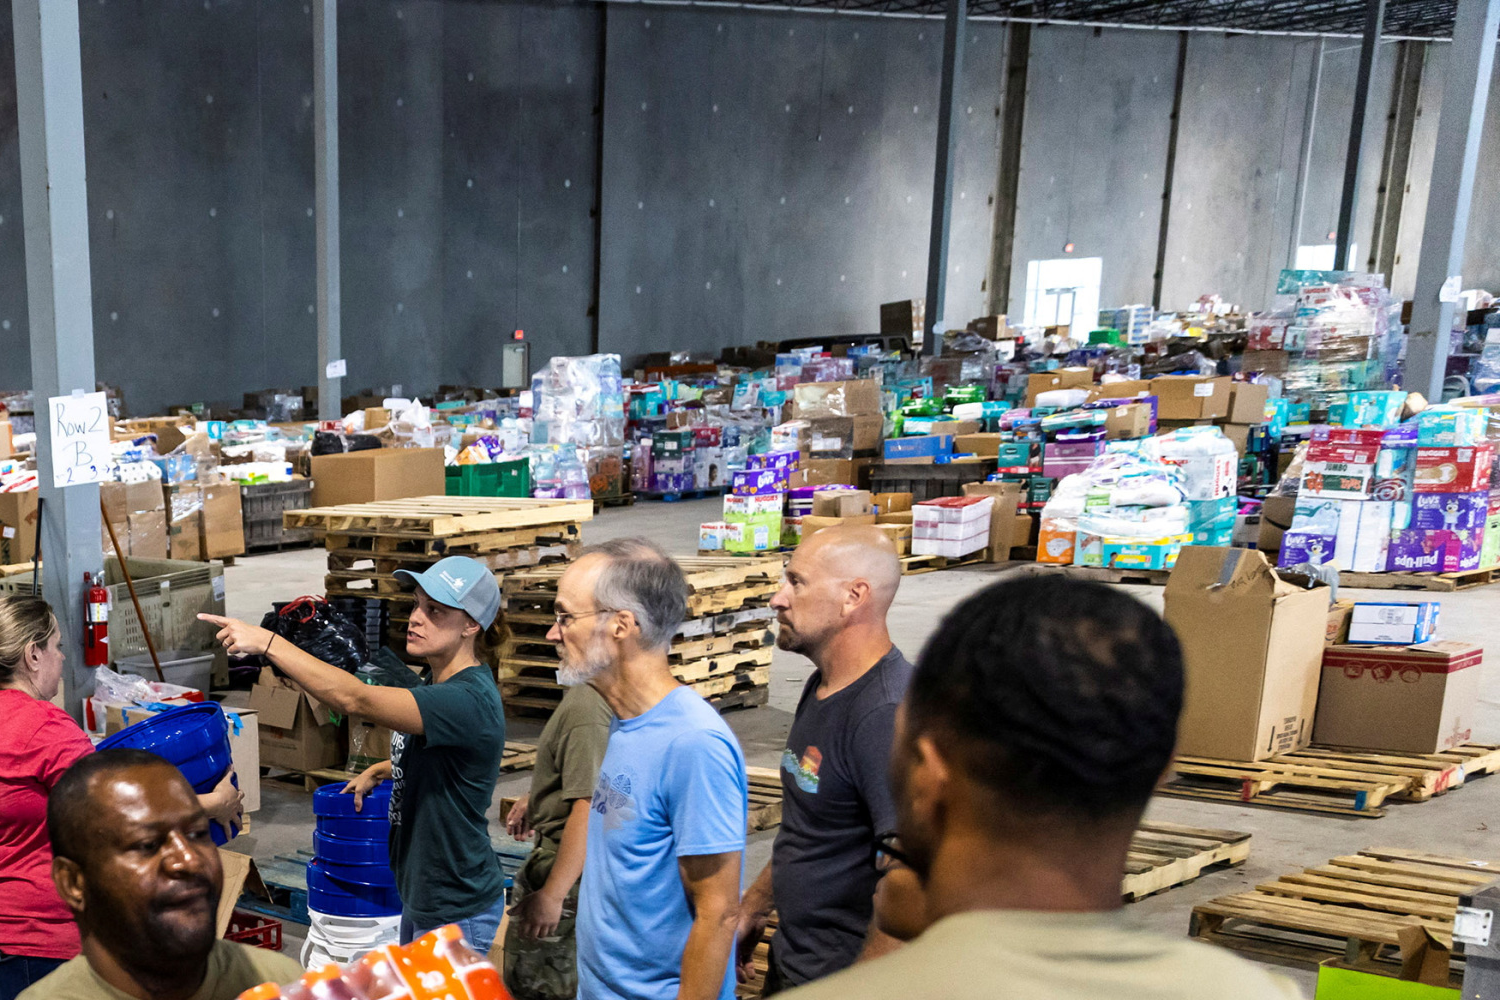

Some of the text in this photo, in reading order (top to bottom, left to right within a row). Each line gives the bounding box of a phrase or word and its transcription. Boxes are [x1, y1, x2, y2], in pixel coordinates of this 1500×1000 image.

[56, 403, 104, 437] Row 2
[74, 440, 94, 467] B
[1324, 463, 1348, 472] JUMBO
